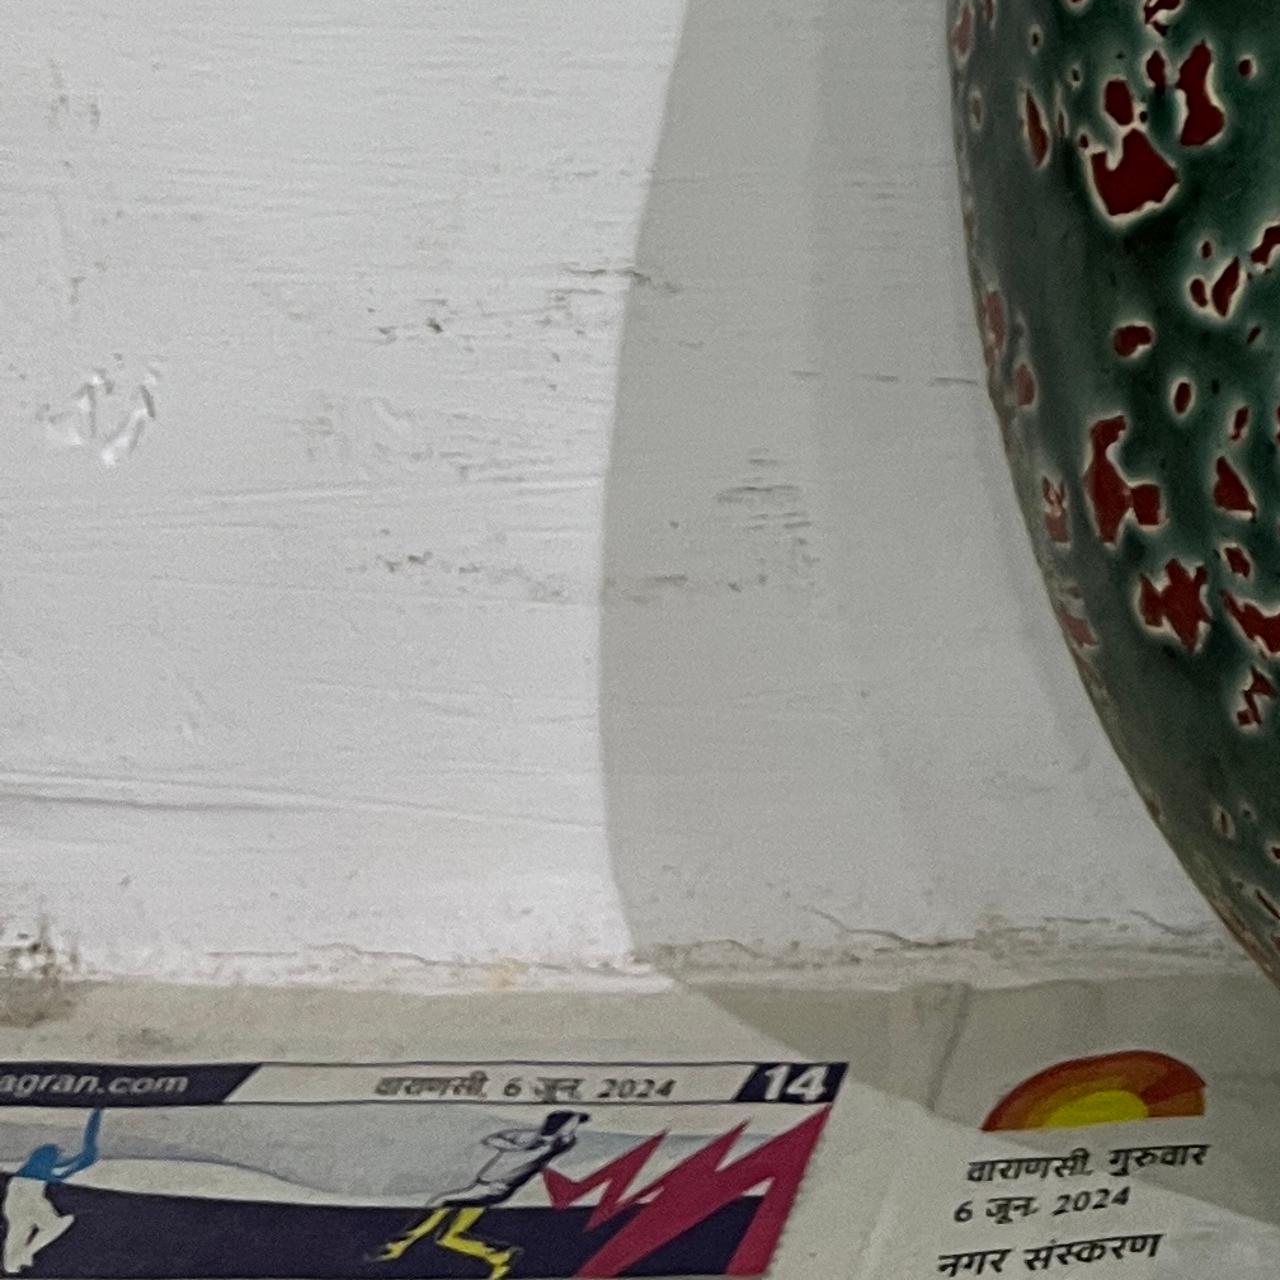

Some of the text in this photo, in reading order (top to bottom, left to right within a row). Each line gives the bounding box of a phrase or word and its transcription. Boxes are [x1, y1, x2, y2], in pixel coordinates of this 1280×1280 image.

[503, 1077, 523, 1099] 6
[597, 1078, 678, 1100] 2024
[764, 1064, 828, 1102] 14
[1108, 1144, 1212, 1177] गुरुवार
[953, 1200, 974, 1223] 6
[1051, 1185, 1131, 1217] 2024
[937, 1233, 1165, 1278] नगर संस्करण
